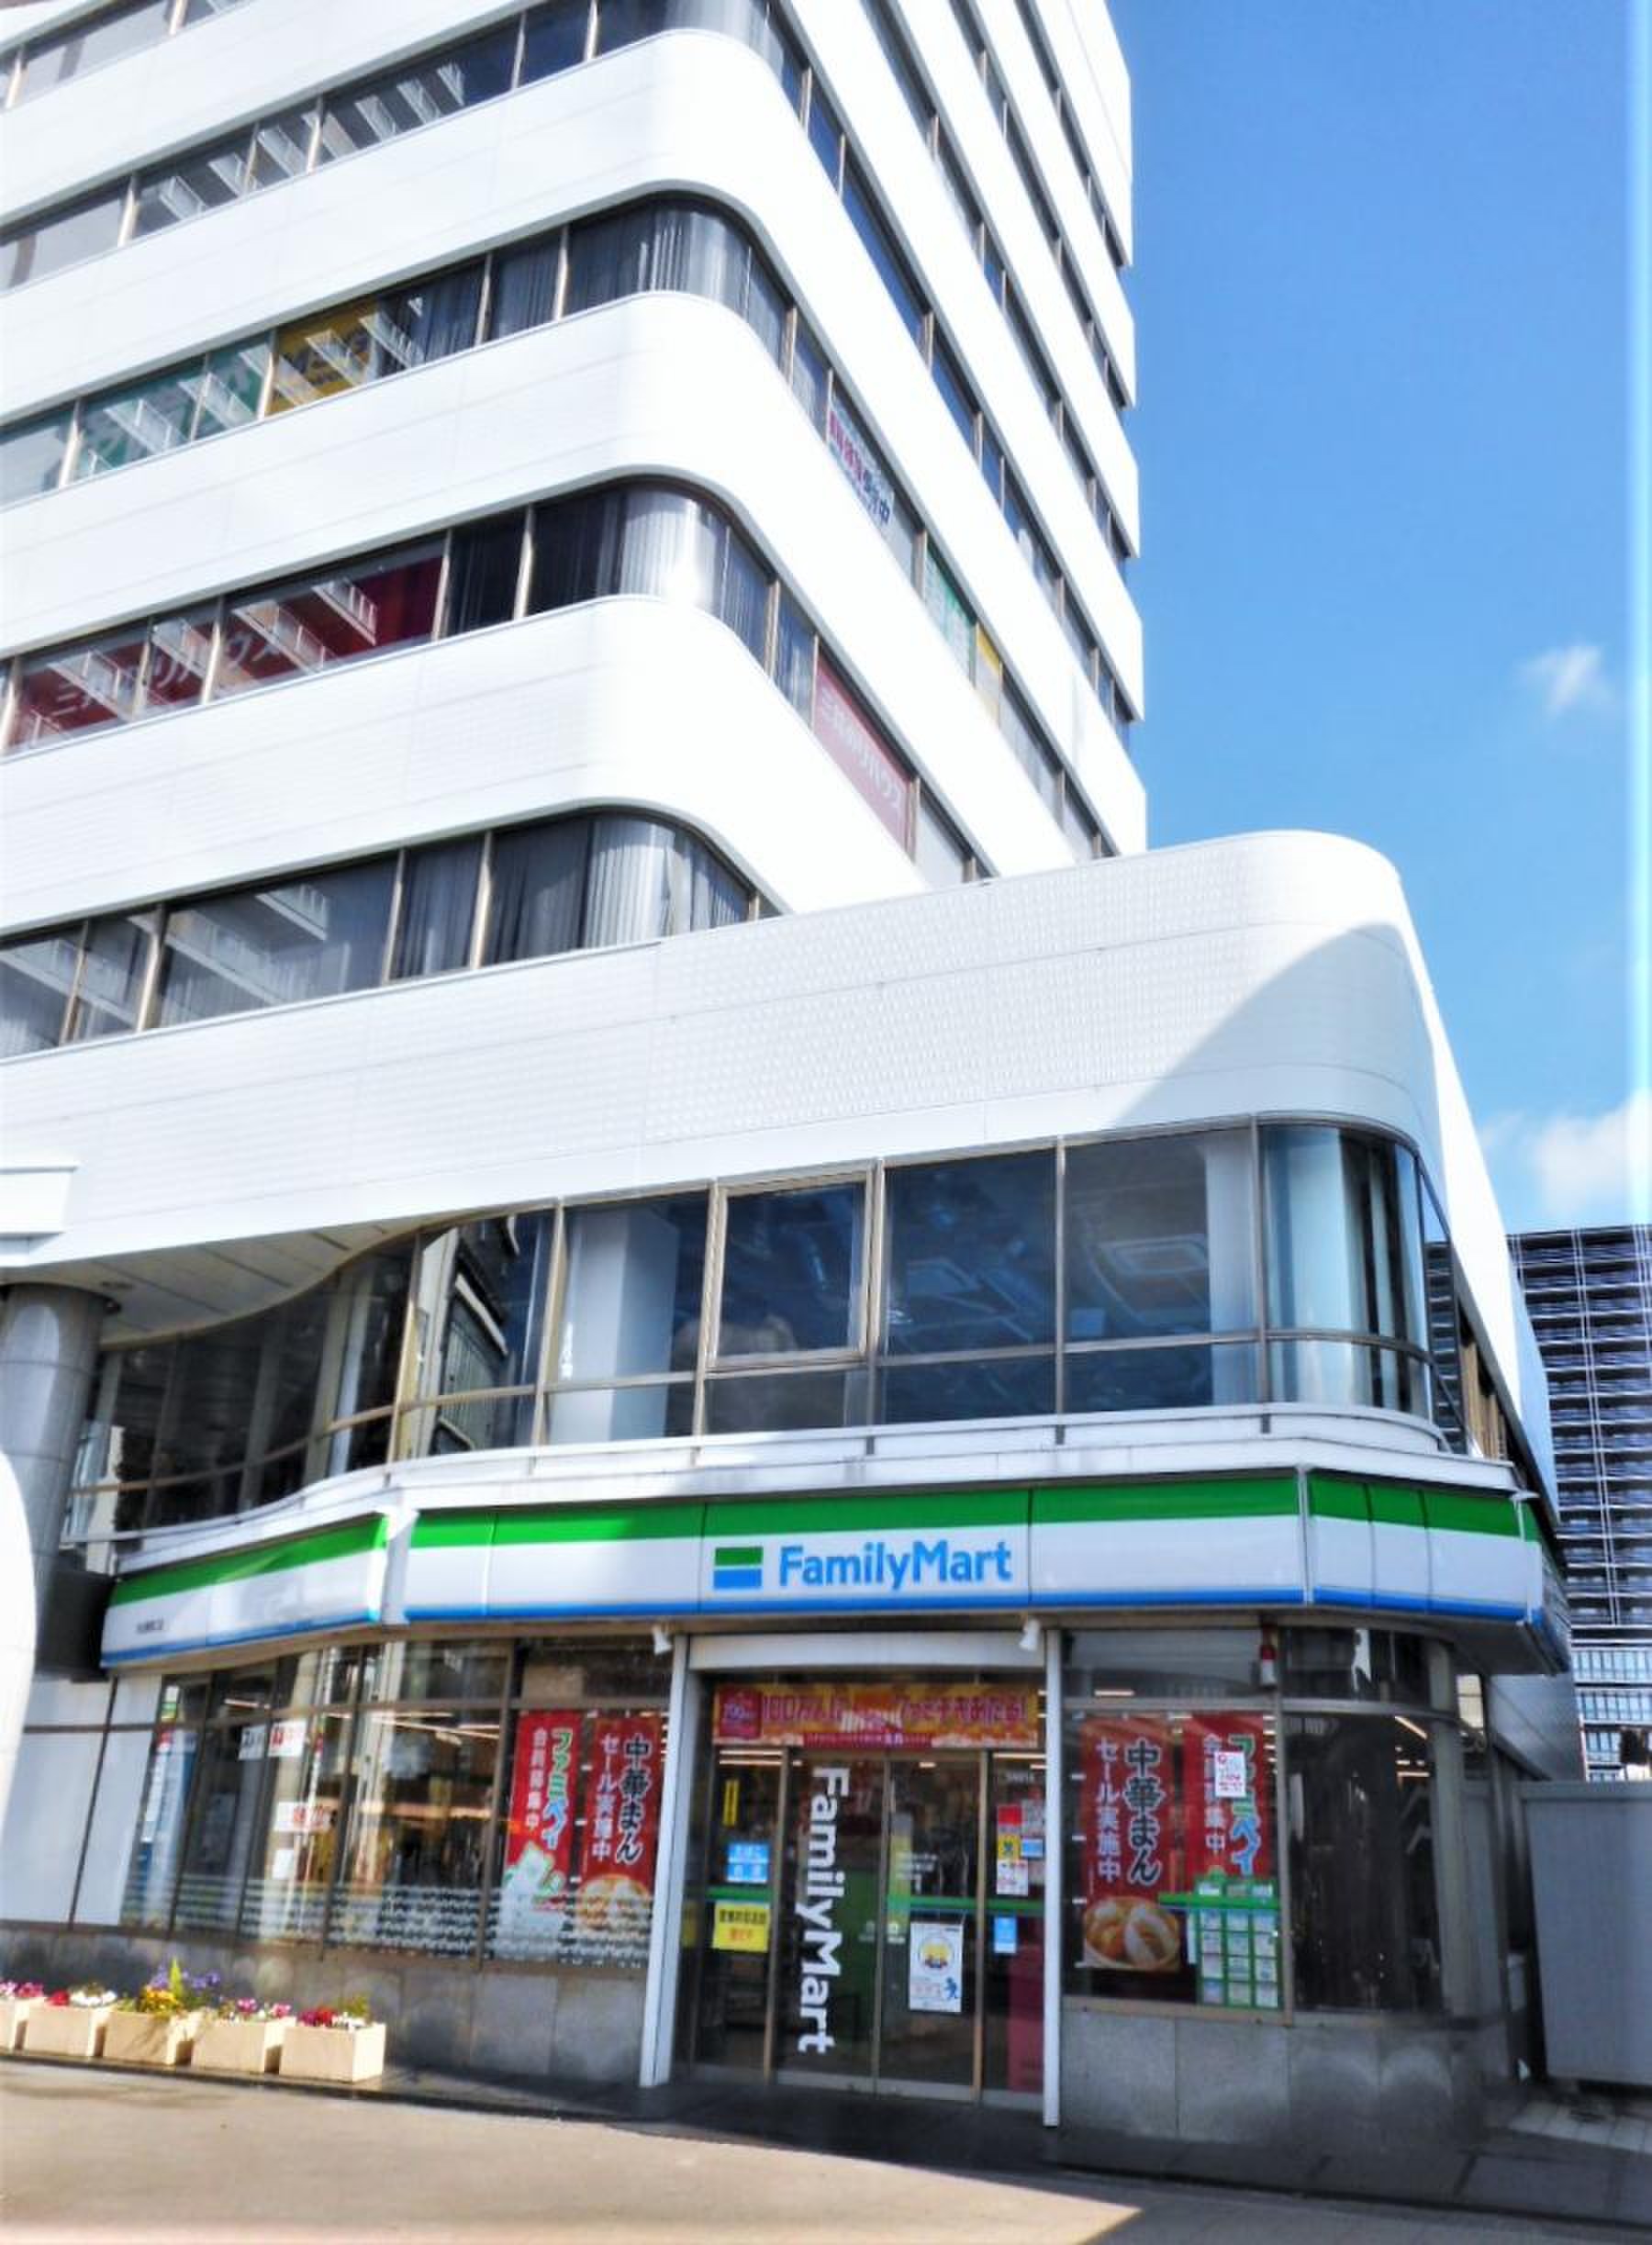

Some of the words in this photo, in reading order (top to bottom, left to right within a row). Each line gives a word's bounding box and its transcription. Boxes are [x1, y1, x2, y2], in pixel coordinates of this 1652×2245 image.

[780, 1540, 1011, 1590] FamilyMart
[541, 1727, 574, 1850] ファミペイ
[591, 1734, 621, 1862] セール実施中
[616, 1733, 653, 1865] 中華まん
[1096, 1737, 1121, 1882] セール実施中
[1122, 1737, 1166, 1887] 中華まん
[1227, 1733, 1262, 1875] フミペイ
[795, 1767, 851, 2054] FamilyMart
